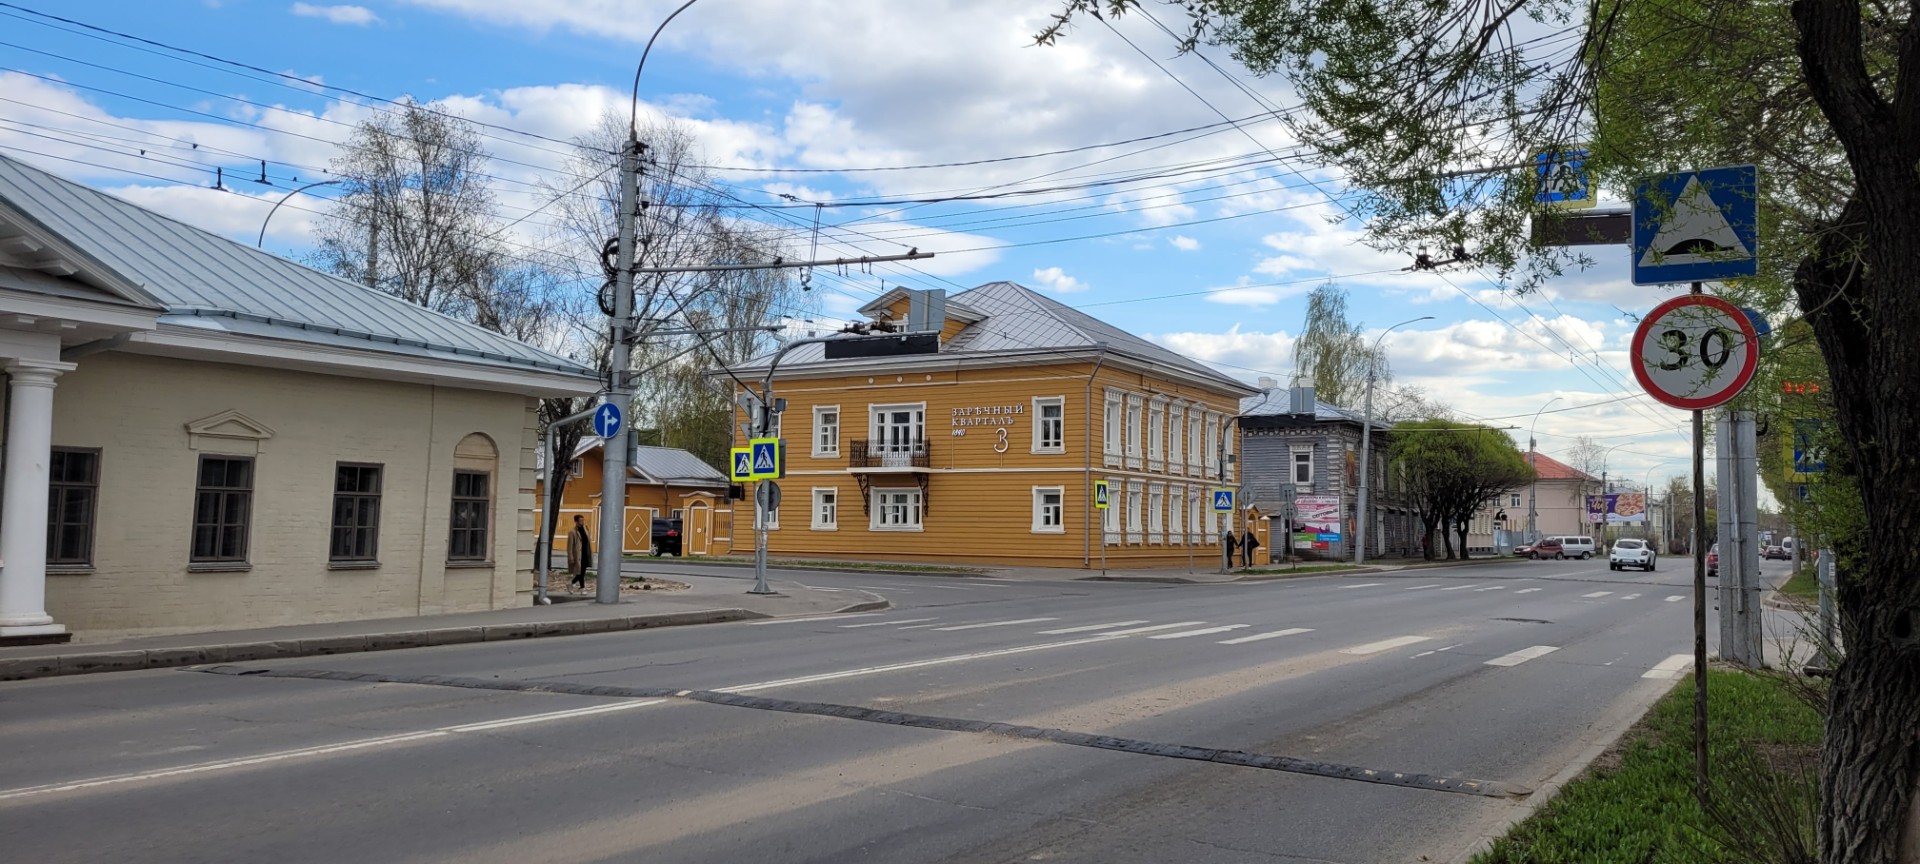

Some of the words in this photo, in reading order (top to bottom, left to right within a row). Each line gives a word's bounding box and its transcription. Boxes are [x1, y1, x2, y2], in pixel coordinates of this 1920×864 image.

[1659, 327, 1730, 371] 30
[952, 416, 1014, 426] КВАРТАЛЪ
[994, 427, 1008, 453] 3
